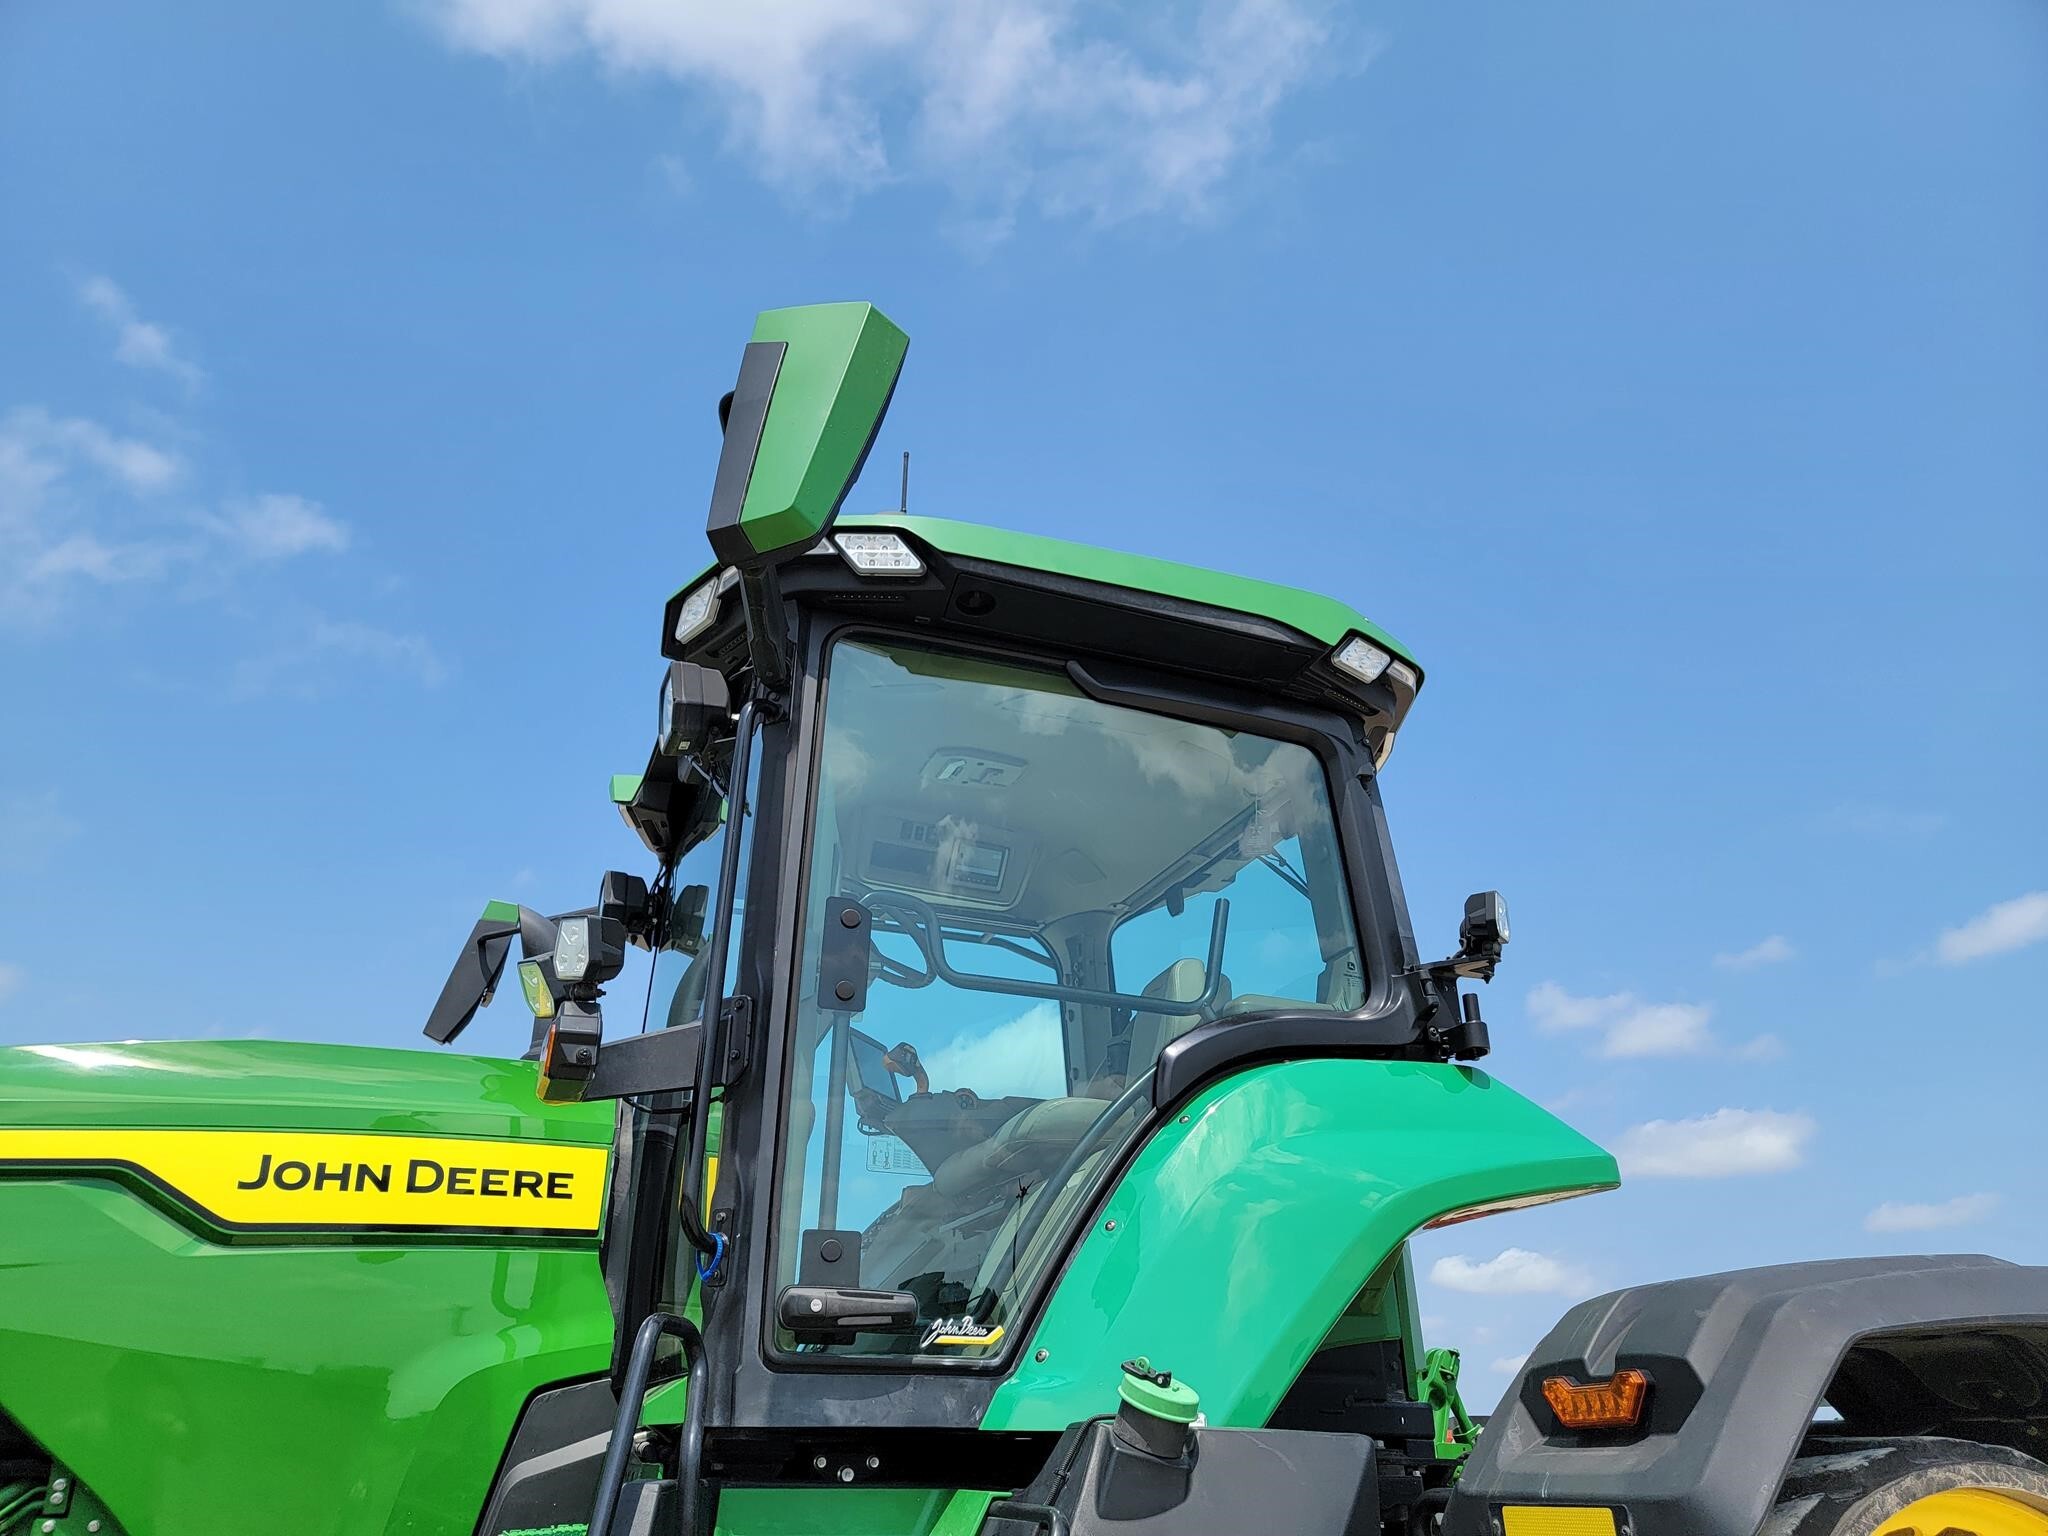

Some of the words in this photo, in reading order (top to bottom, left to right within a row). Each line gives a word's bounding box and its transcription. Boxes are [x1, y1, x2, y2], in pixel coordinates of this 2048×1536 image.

[237, 1154, 392, 1194] JOHN
[405, 1159, 575, 1200] DEERE
[920, 1318, 960, 1348] John
[959, 1315, 988, 1336] Deere
